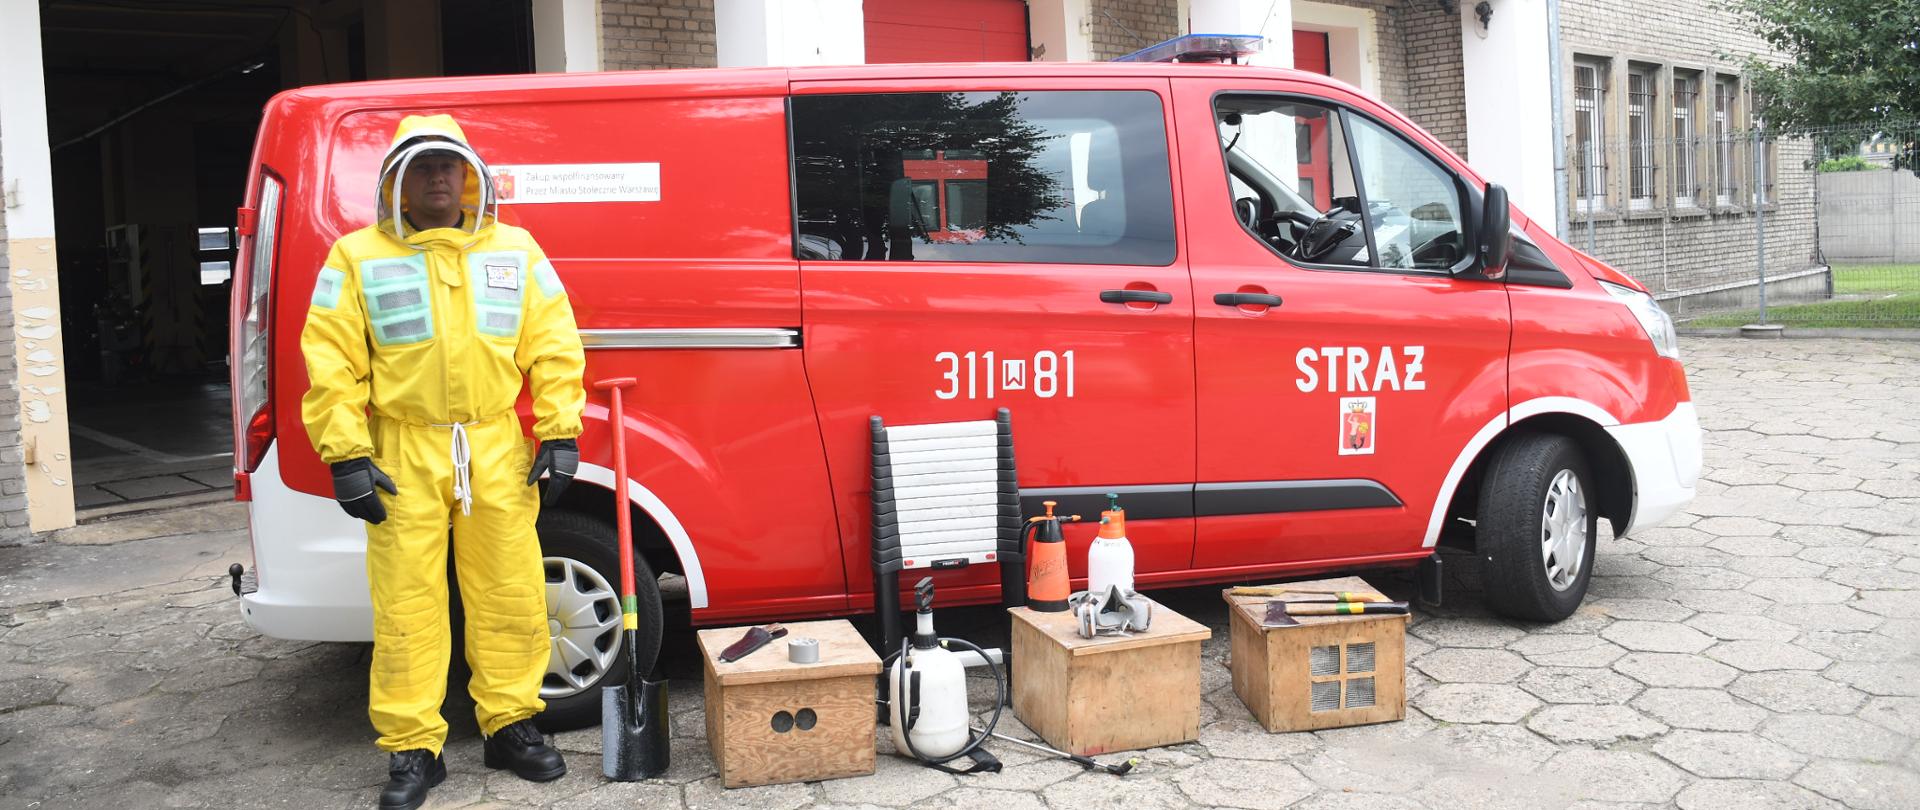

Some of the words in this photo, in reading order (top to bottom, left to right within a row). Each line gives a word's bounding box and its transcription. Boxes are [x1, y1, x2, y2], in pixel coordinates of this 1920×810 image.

[526, 172, 550, 182] Zakup
[526, 187, 547, 195] Przez
[549, 186, 577, 195] Miasto
[935, 351, 994, 399] 311
[1004, 361, 1024, 388] W
[1034, 350, 1073, 398] 81
